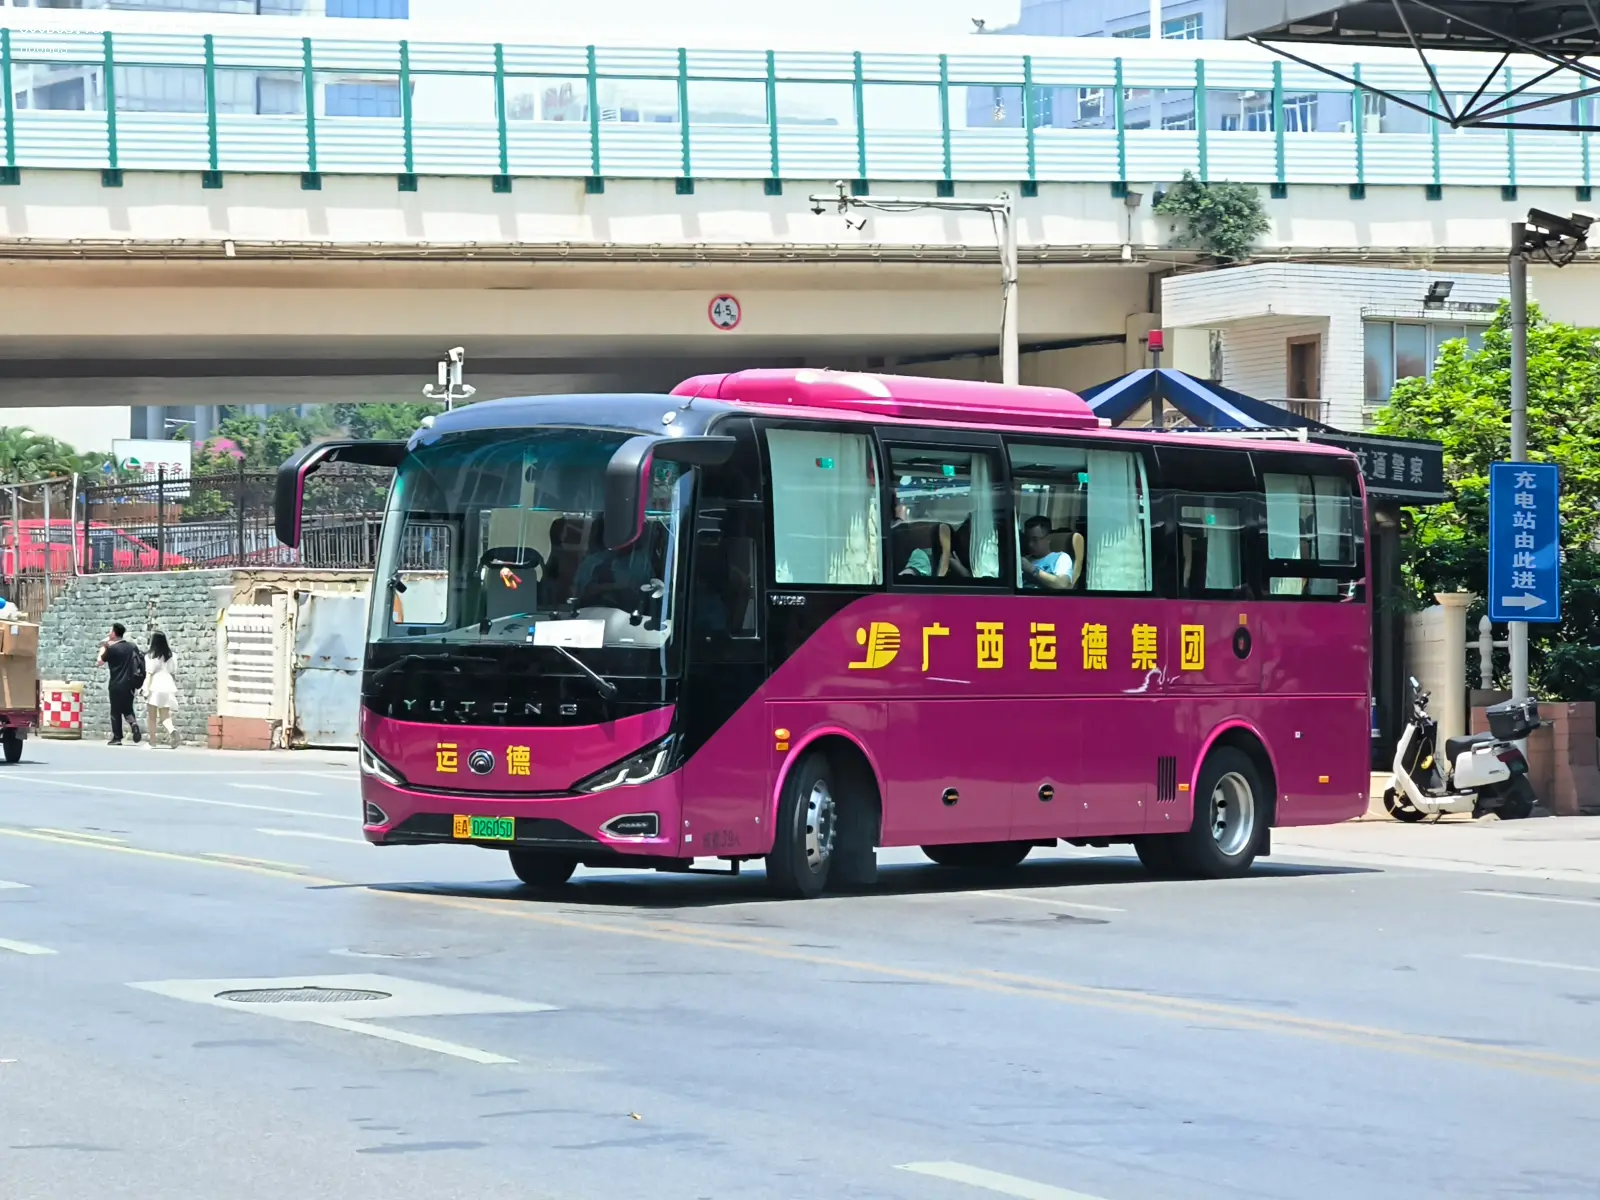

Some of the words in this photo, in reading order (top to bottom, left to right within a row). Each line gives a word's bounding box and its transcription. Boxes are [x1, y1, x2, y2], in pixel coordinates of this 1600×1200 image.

[1511, 471, 1538, 590] 充电站由此进
[921, 621, 1205, 672] 广西运德集团
[403, 699, 578, 716] YUTONG
